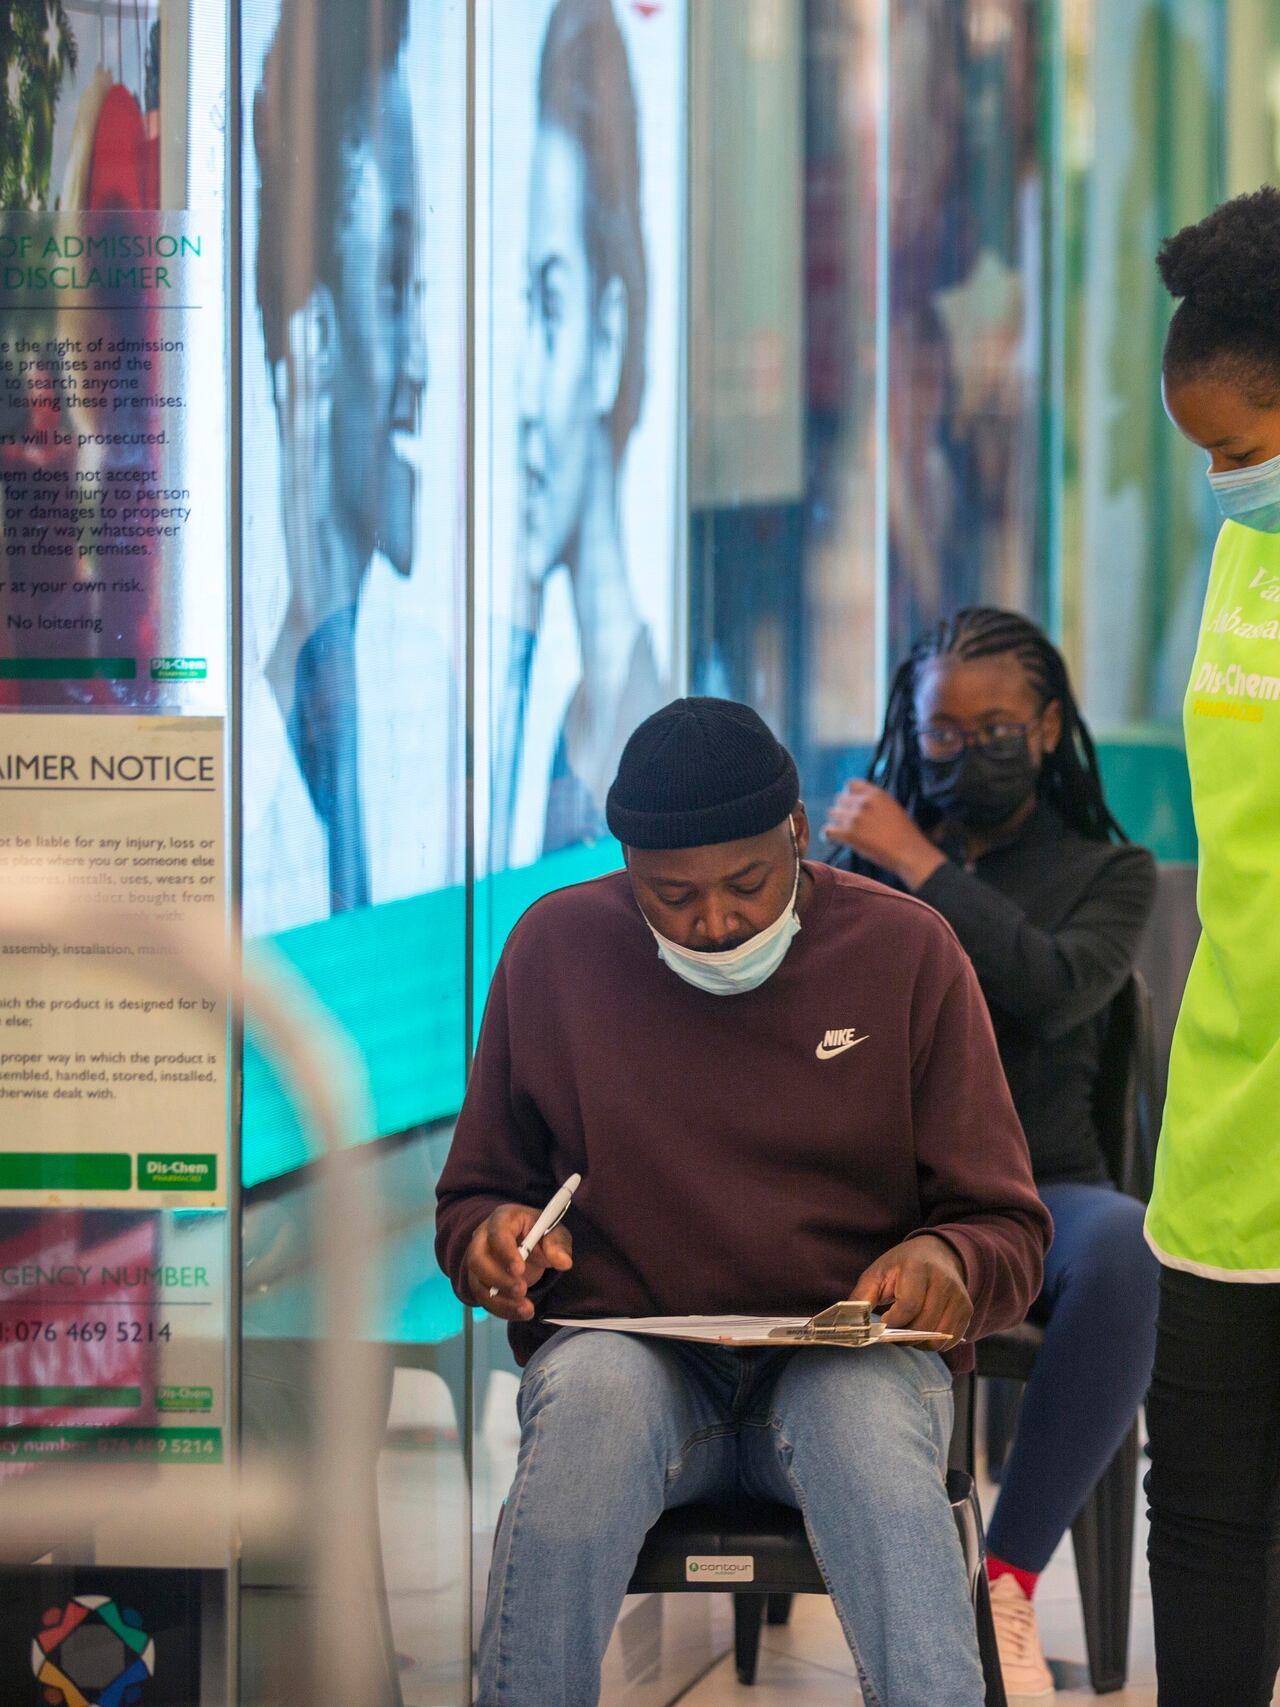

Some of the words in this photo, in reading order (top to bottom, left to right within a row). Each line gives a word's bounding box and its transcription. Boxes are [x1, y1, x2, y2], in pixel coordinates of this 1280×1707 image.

[0, 236, 32, 258] OF
[42, 236, 201, 258] ADMISSION
[6, 267, 172, 289] DISCLAIMER
[16, 339, 39, 352] the
[46, 339, 82, 357] right
[87, 339, 102, 352] of
[107, 339, 184, 352] admission
[19, 357, 88, 375] premises
[93, 357, 121, 371] and
[127, 357, 152, 371] the
[5, 377, 21, 389] to
[27, 375, 77, 389] search
[82, 378, 138, 393] anyone
[9, 394, 61, 411] leaving
[66, 394, 107, 407] these
[113, 394, 186, 412] premises.
[24, 432, 48, 445] will
[54, 431, 71, 445] be
[78, 431, 169, 449] prosecuted.
[33, 468, 69, 482] does
[75, 470, 101, 482] not
[107, 470, 157, 486] accept
[5, 487, 28, 500] for
[33, 490, 58, 504] any
[66, 487, 108, 504] injury
[115, 489, 130, 500] to
[137, 489, 190, 504] person
[6, 508, 23, 518] or
[29, 505, 95, 523] damages
[101, 507, 117, 518] to
[123, 507, 192, 523] property
[4, 525, 17, 537] in
[22, 527, 48, 542] any
[54, 527, 85, 541] way
[90, 524, 180, 537] whatsoever
[6, 545, 26, 555] on
[31, 542, 72, 555] these
[79, 543, 152, 559] premises.
[11, 581, 27, 592] at
[32, 581, 66, 596] your
[73, 581, 106, 592] own
[112, 579, 144, 592] risk.
[7, 616, 32, 629] No
[38, 615, 103, 633] loitering
[91, 755, 215, 781] NOTICE
[16, 836, 31, 848] be
[36, 836, 70, 848] liable
[75, 836, 94, 848] for
[99, 838, 122, 851] any
[170, 837, 194, 848] loss
[200, 839, 215, 848] or
[48, 855, 84, 866] where
[88, 857, 111, 870] you
[115, 857, 129, 866] or
[133, 856, 188, 866] someone
[192, 855, 215, 866] else
[120, 874, 152, 886] uses,
[156, 874, 195, 885] wears
[200, 875, 215, 885] or
[129, 891, 176, 907] bought
[181, 891, 215, 903] from
[26, 998, 46, 1010] the
[50, 998, 100, 1013] product
[104, 999, 114, 1010] is
[118, 998, 174, 1013] designed
[178, 998, 196, 1010] for
[202, 998, 216, 1013] by
[823, 1028, 856, 1047] NIKE
[1, 1054, 41, 1068] proper
[48, 1054, 70, 1068] way
[75, 1053, 86, 1064] in
[90, 1052, 126, 1064] which
[130, 1052, 150, 1064] the
[154, 1052, 202, 1068] product
[208, 1053, 216, 1064] is
[56, 1070, 109, 1083] handled,
[112, 1070, 157, 1083] stored,
[160, 1070, 216, 1083] installed,
[53, 1088, 82, 1100] dealt
[86, 1088, 117, 1100] with.
[146, 1161, 208, 1175] Dis-Chem
[1, 1266, 90, 1287] GENCY
[102, 1266, 209, 1287] NUMBER
[15, 1322, 57, 1342] 076
[67, 1322, 107, 1342] 469
[117, 1322, 172, 1343] 5214
[171, 1439, 214, 1454] 5214
